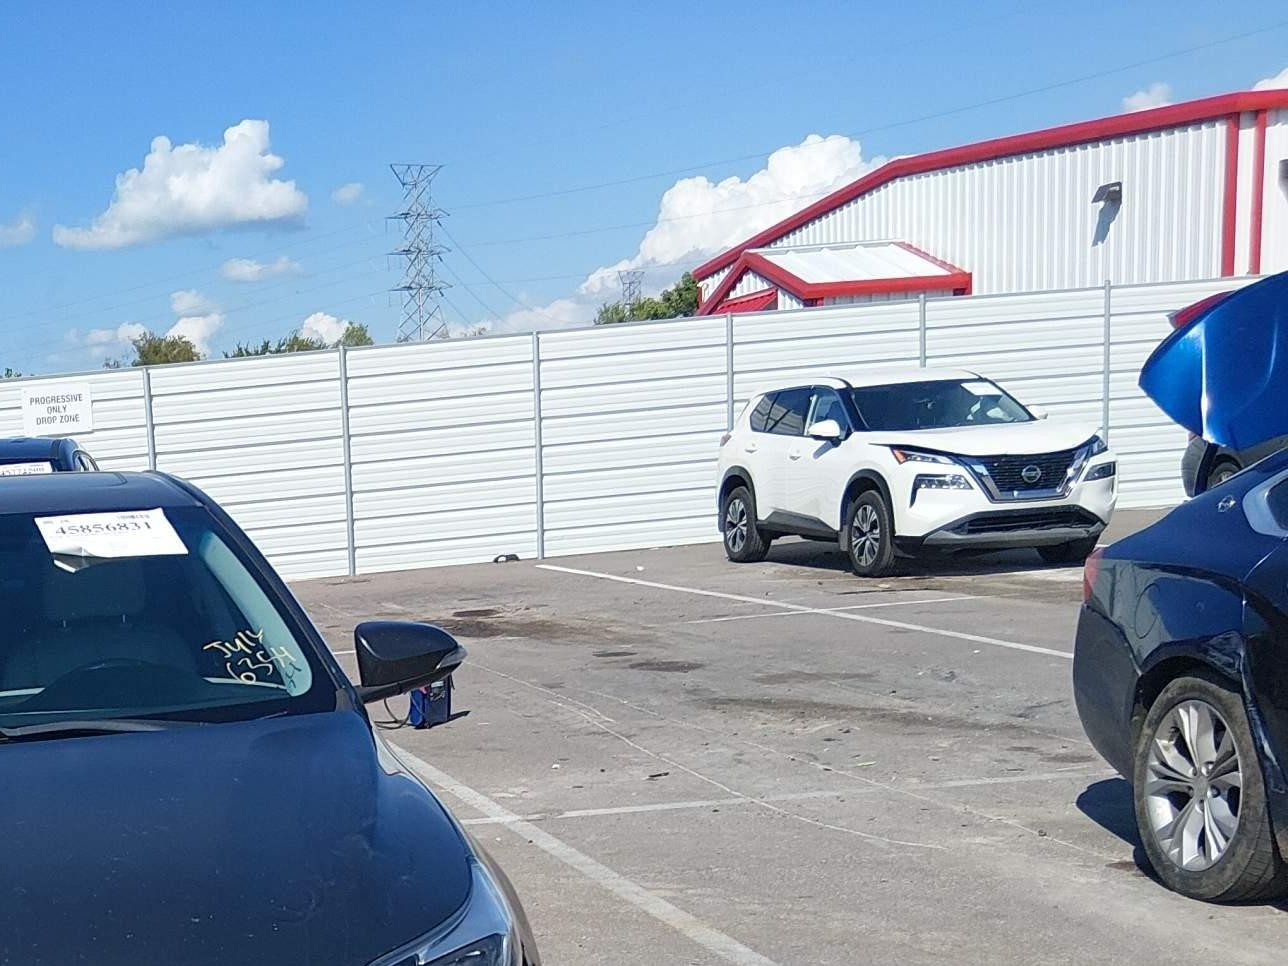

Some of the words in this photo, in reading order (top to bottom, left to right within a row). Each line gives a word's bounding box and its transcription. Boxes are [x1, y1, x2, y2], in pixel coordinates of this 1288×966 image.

[30, 394, 82, 405] PROGRESSIVE
[47, 405, 67, 414] ONLY
[36, 416, 57, 425] DROP
[60, 414, 80, 424] ZONE
[55, 521, 152, 535] 45856831
